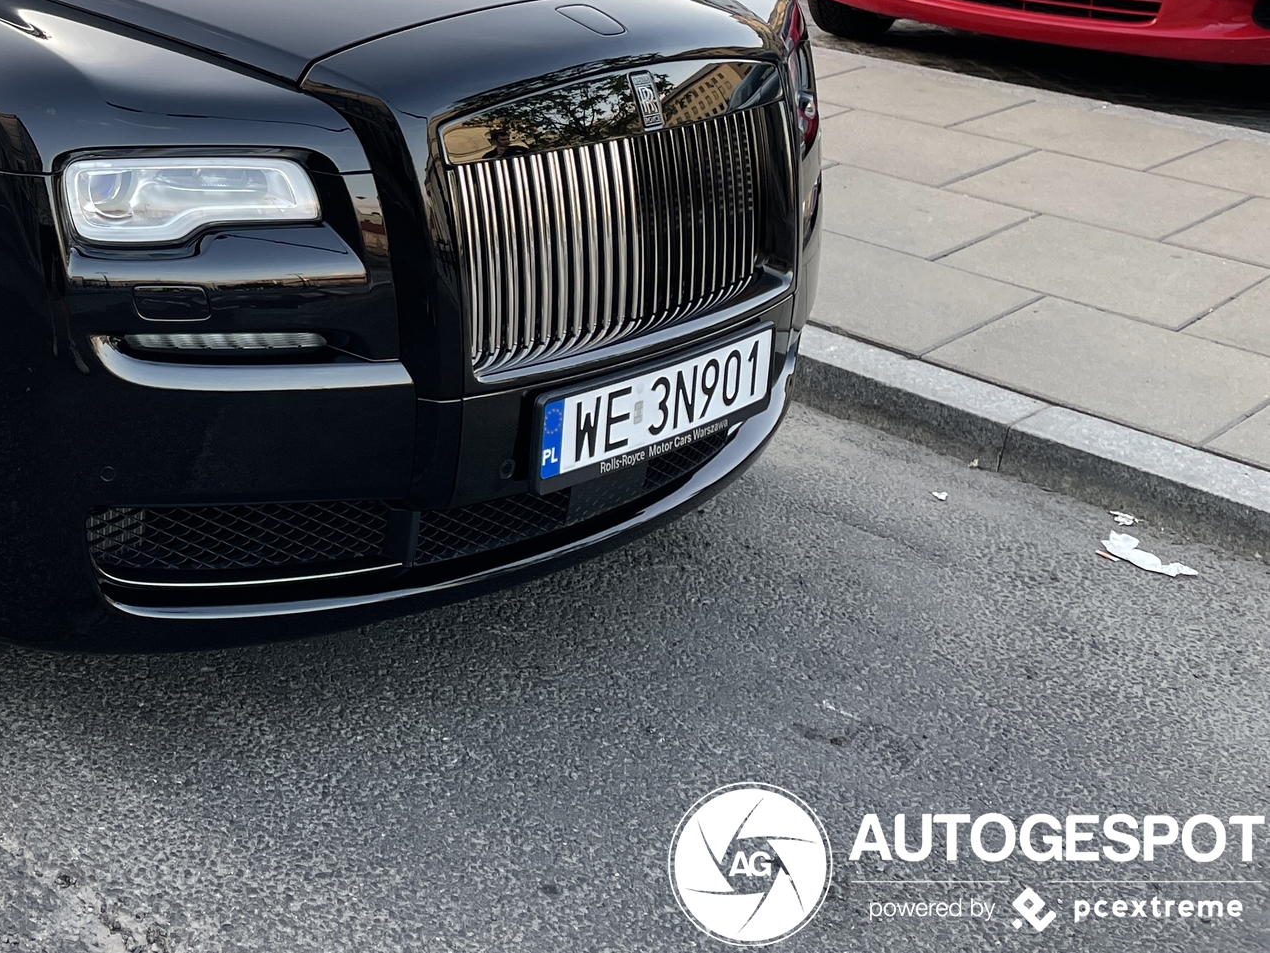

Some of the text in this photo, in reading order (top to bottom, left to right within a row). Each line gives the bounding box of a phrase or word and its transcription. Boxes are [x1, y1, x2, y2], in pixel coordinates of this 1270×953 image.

[574, 339, 760, 463] WE 3N901
[542, 448, 559, 467] PL
[600, 418, 729, 474] Rolls-Royce Motor Cars Warszawa
